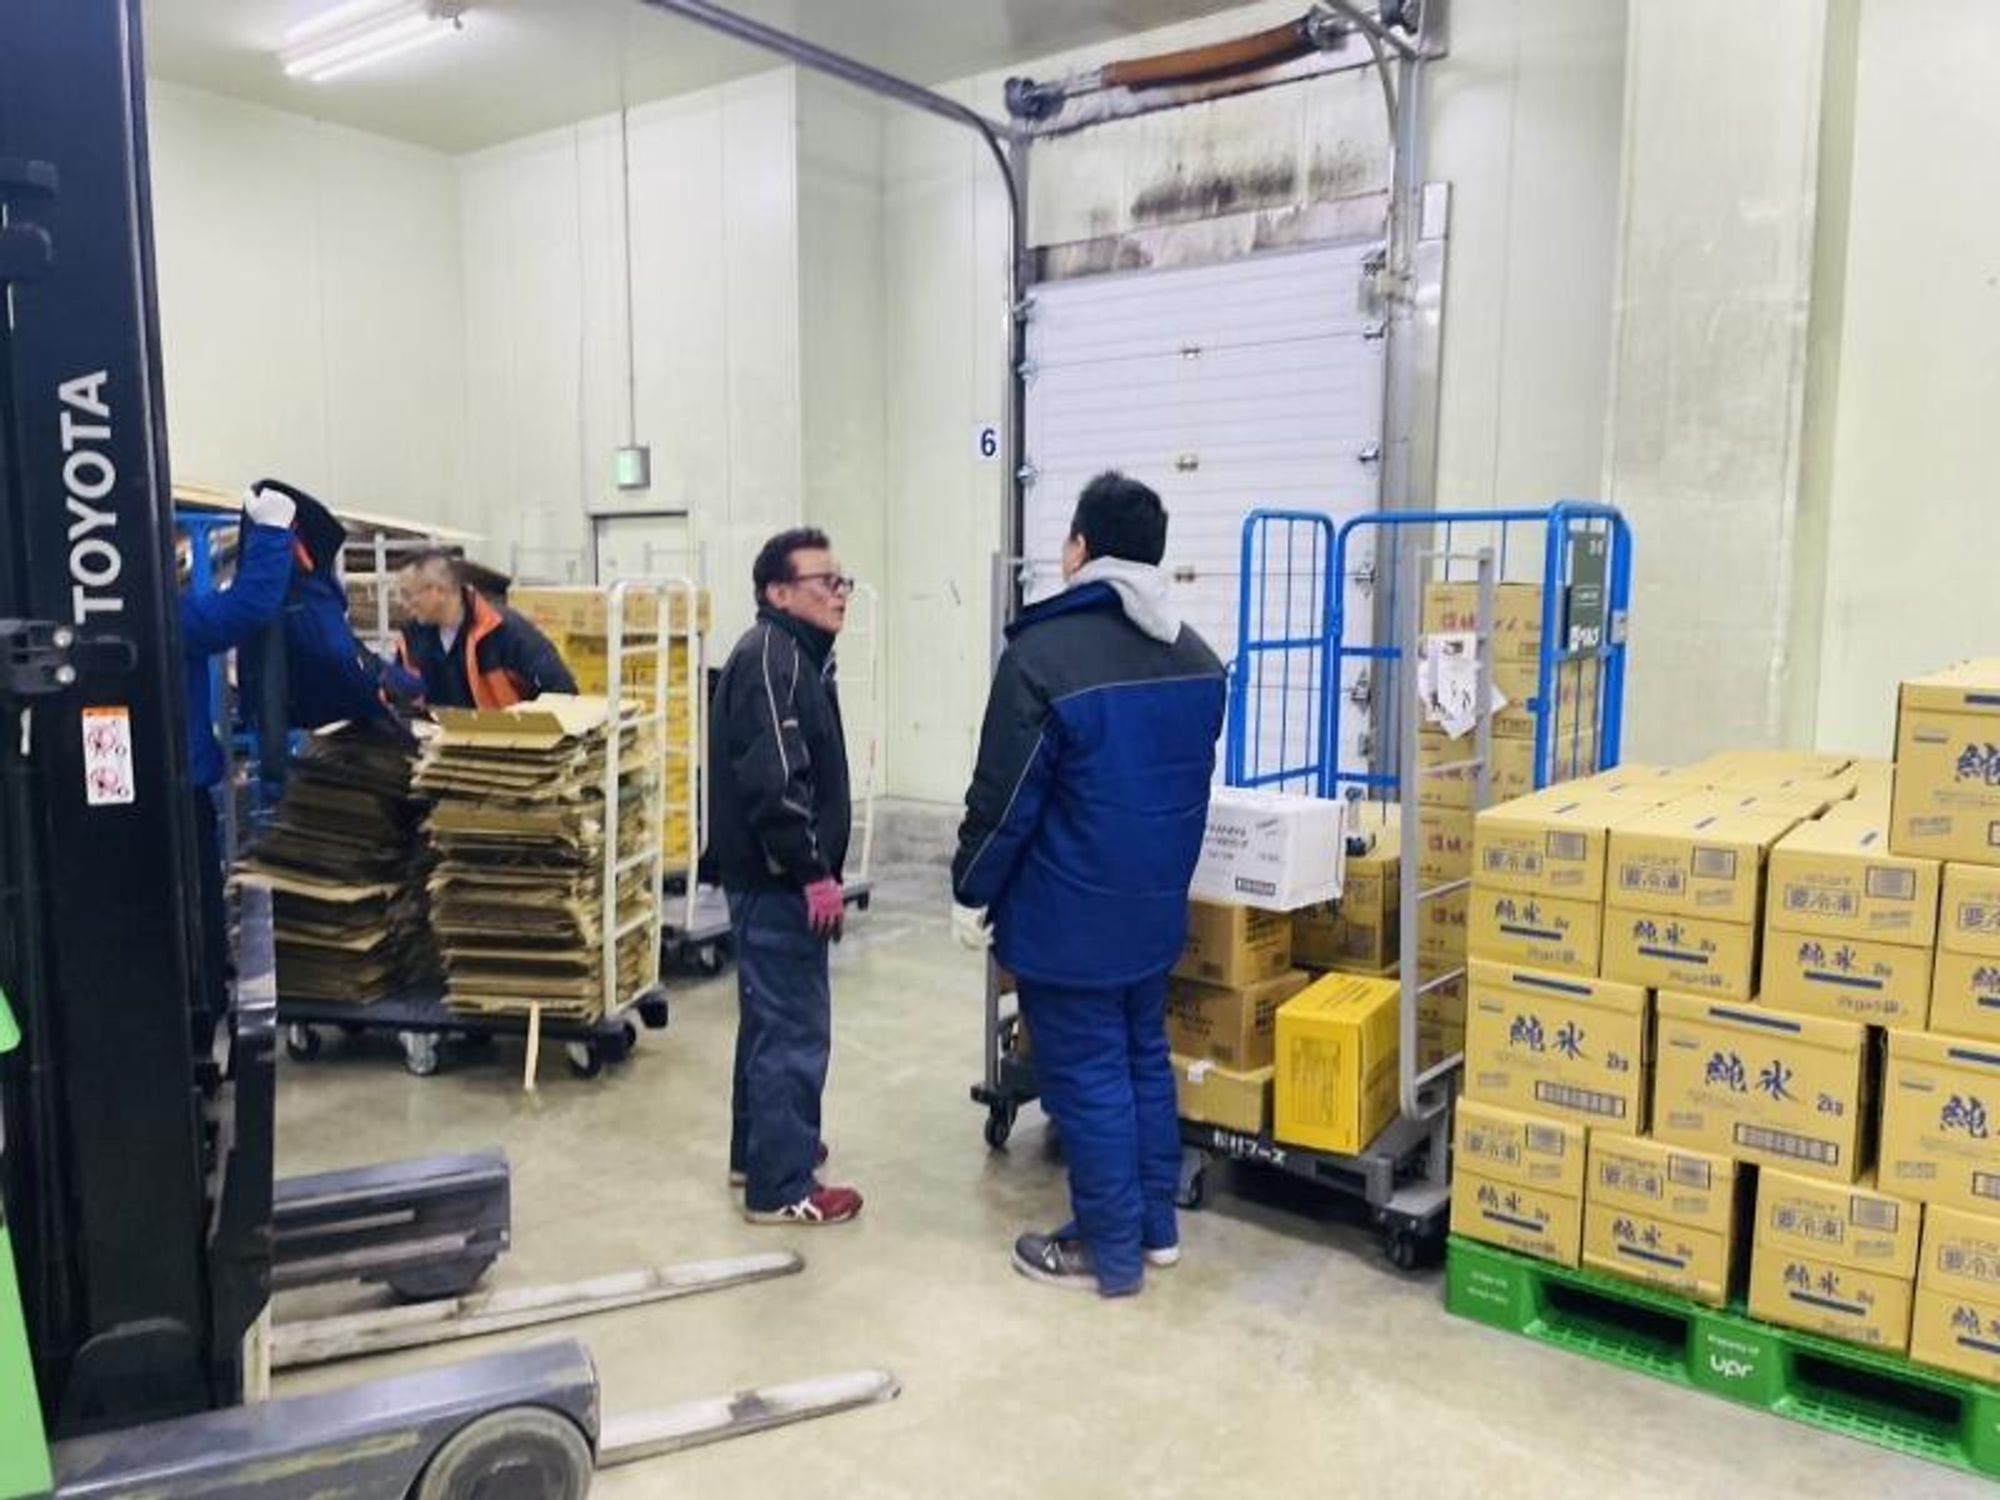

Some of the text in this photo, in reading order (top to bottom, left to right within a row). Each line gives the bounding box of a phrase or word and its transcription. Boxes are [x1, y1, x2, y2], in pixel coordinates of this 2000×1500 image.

[981, 428, 996, 457] 6
[59, 370, 124, 624] TOYOTA
[1706, 1052, 1800, 1102] 純氷
[1941, 1095, 2000, 1138] 純
[1710, 1354, 1754, 1379] upr
